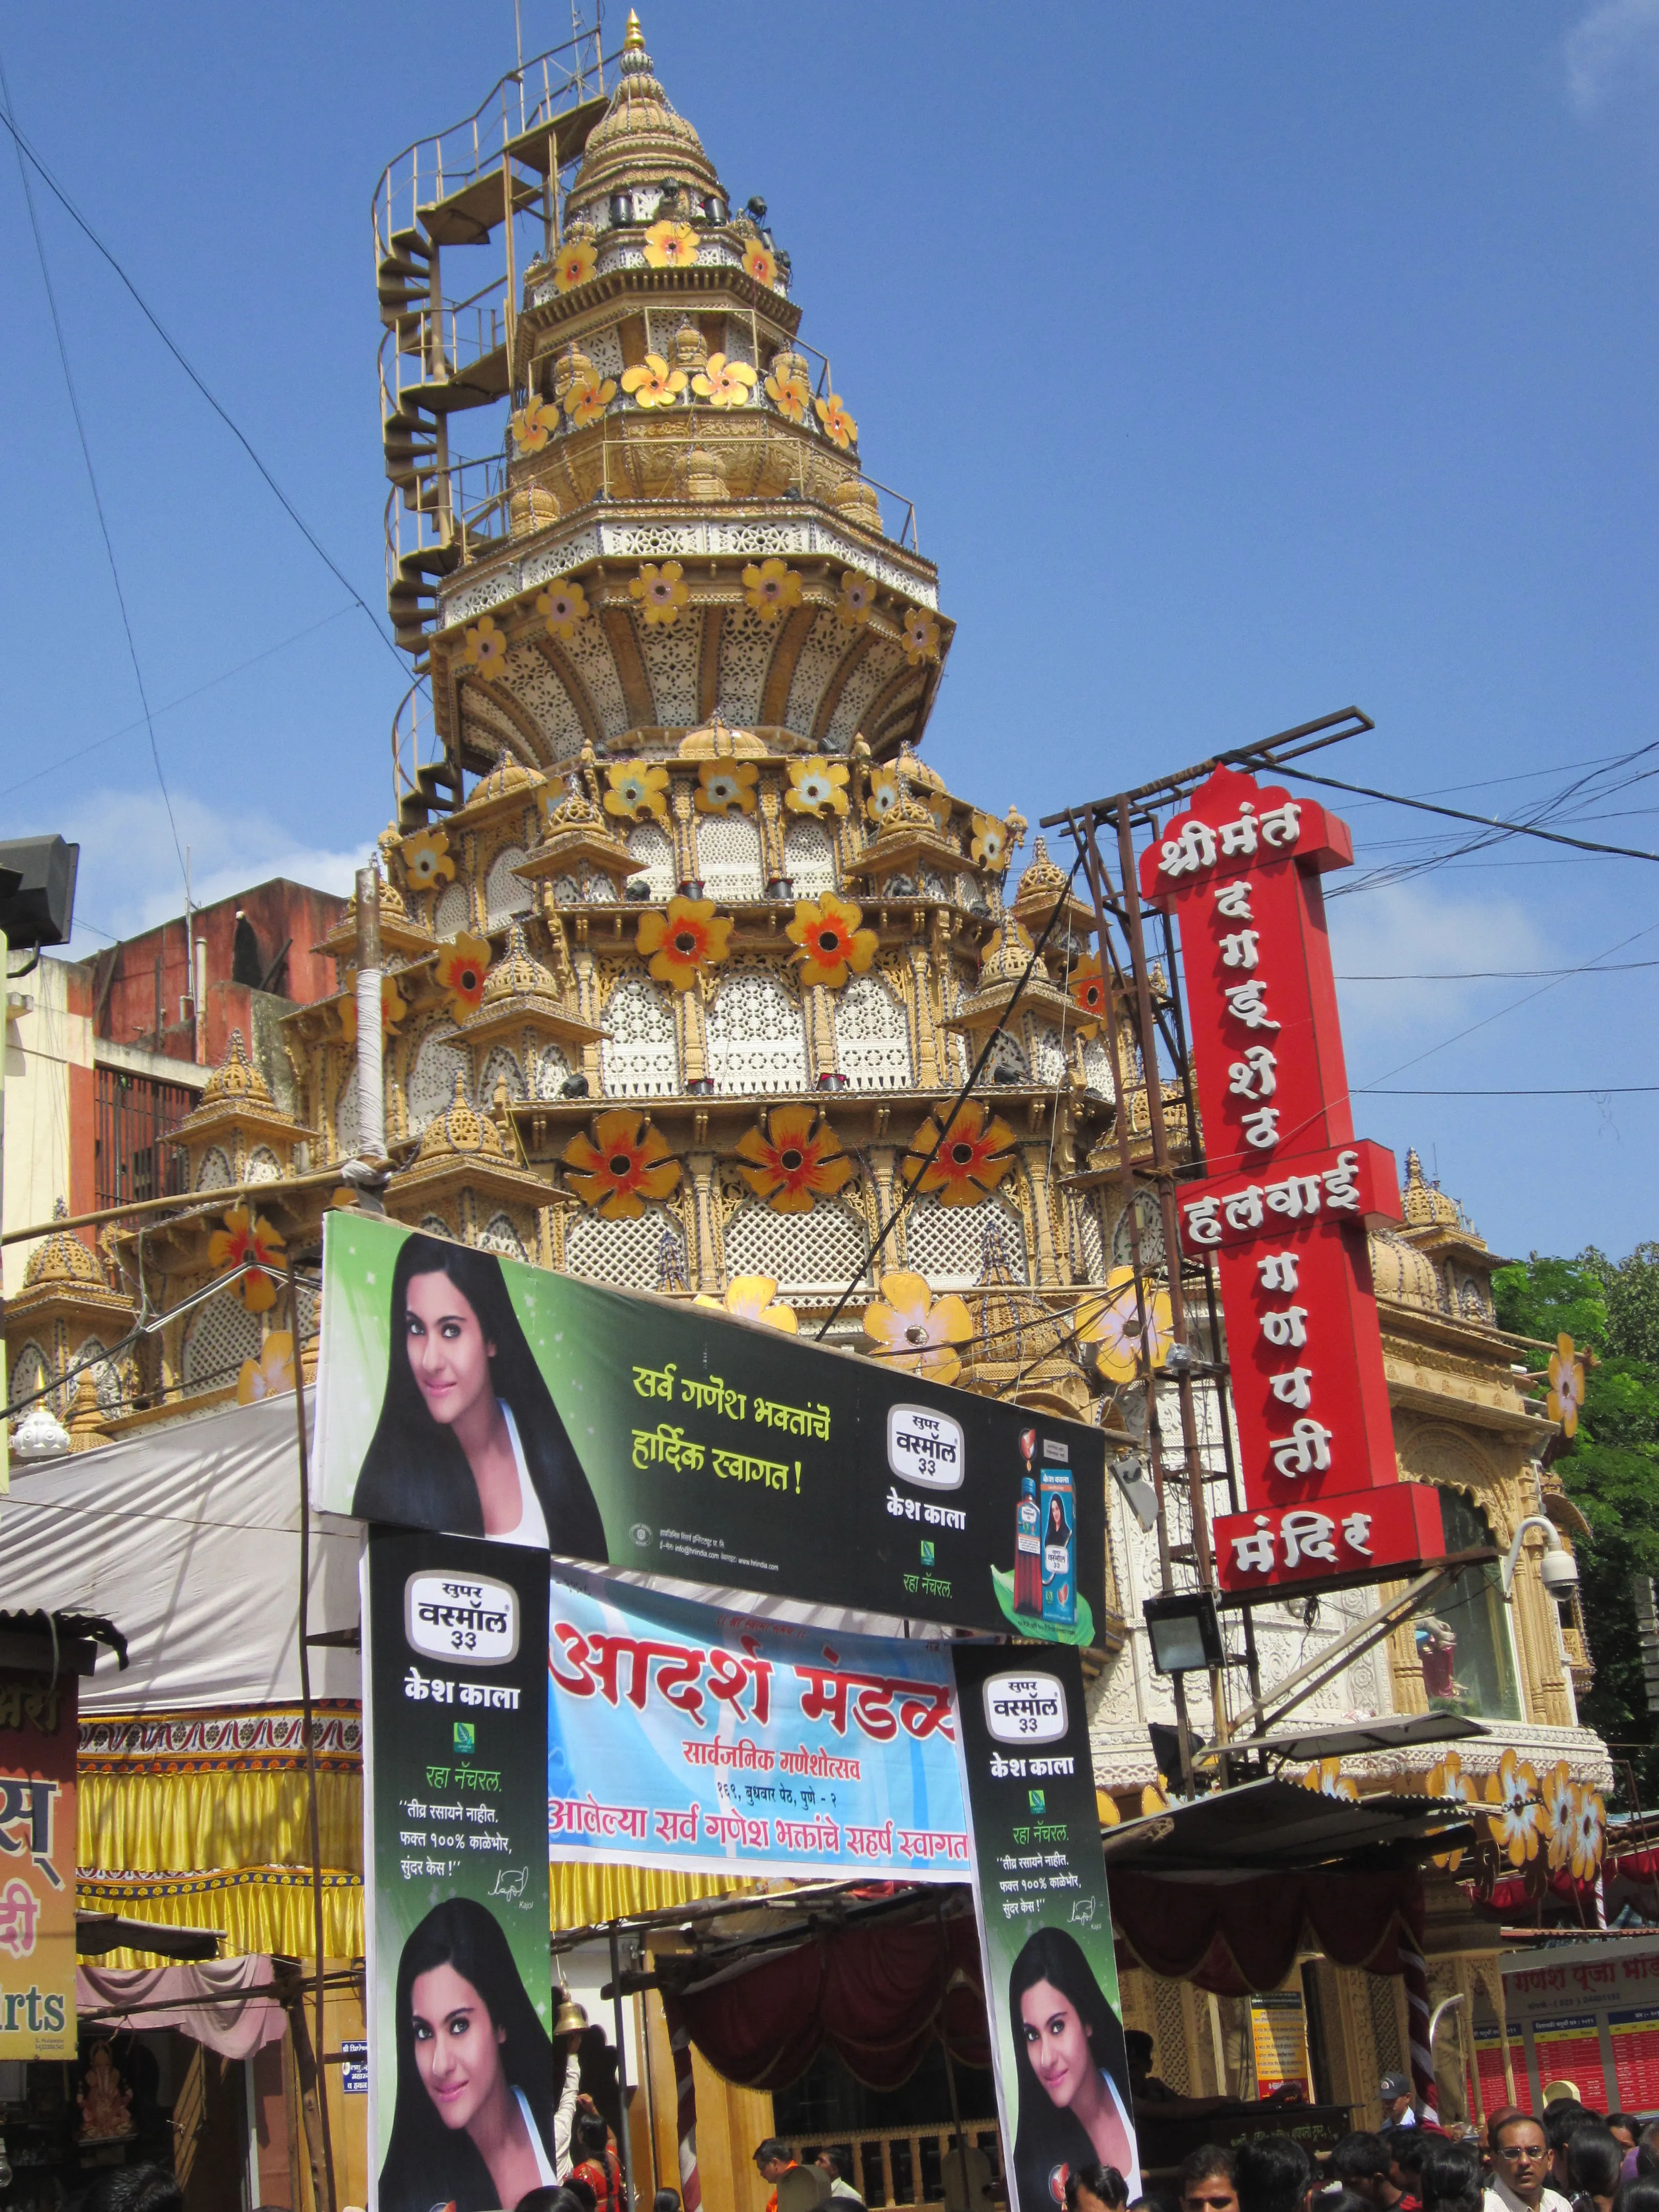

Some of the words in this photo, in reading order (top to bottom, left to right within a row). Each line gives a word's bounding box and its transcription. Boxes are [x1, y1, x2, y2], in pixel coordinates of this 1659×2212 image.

[1158, 801, 1302, 877] श्रीमंत
[1183, 1151, 1360, 1245] हलवाई
[632, 1363, 676, 1401] सर्व
[681, 1375, 747, 1420] गणेश
[754, 1397, 831, 1441] भक्तांचे
[912, 1415, 940, 1431] सुपर
[631, 1423, 705, 1473] हार्दिक
[711, 1448, 789, 1492] स्वागत
[897, 1432, 956, 1463] वस्मॉल
[918, 1458, 936, 1476] ३३
[887, 1486, 921, 1521] केश
[924, 1503, 966, 1530] काला
[1231, 1511, 1374, 1572] मंदिर
[442, 1583, 482, 1599] सुपर
[904, 1573, 918, 1592] रहा
[418, 1600, 507, 1633] वस्मॉल
[451, 1630, 477, 1651] ३३
[549, 1622, 776, 1729] आदर्श
[1008, 1682, 1037, 1692] सुपर
[405, 1667, 455, 1704] केश
[459, 1683, 521, 1709] काला
[993, 1693, 1057, 1718] वस्मॉल
[1019, 1717, 1038, 1734] ३३
[682, 1735, 775, 1772] सार्वजनिक
[779, 1744, 862, 1781] गणेशोत्सव
[990, 1753, 1026, 1778] केश
[1028, 1757, 1074, 1776] काला
[426, 1766, 451, 1789] रहा
[746, 1784, 776, 1807] बुधवार
[801, 1785, 816, 1810] पुणे
[429, 1801, 463, 1821] रसायने
[466, 1803, 498, 1824] नाहीत.
[399, 1832, 426, 1847] फक्त
[548, 1794, 648, 1839] आलेल्या
[656, 1801, 698, 1844] सर्व
[705, 1809, 769, 1851] गणेश
[775, 1816, 839, 1853] भक्तांचे
[845, 1817, 892, 1860] सहर्ष
[898, 1831, 969, 1862] स्वागत
[1013, 1826, 1030, 1845] रहा
[400, 1856, 423, 1879] सुंदर
[426, 1856, 445, 1876] केस
[1018, 1853, 1043, 1869] रसायने
[999, 1881, 1019, 1892] फक्त
[519, 1901, 534, 1910] Kajol
[1003, 1900, 1019, 1920] सुंदर
[1020, 1899, 1035, 1913] केस
